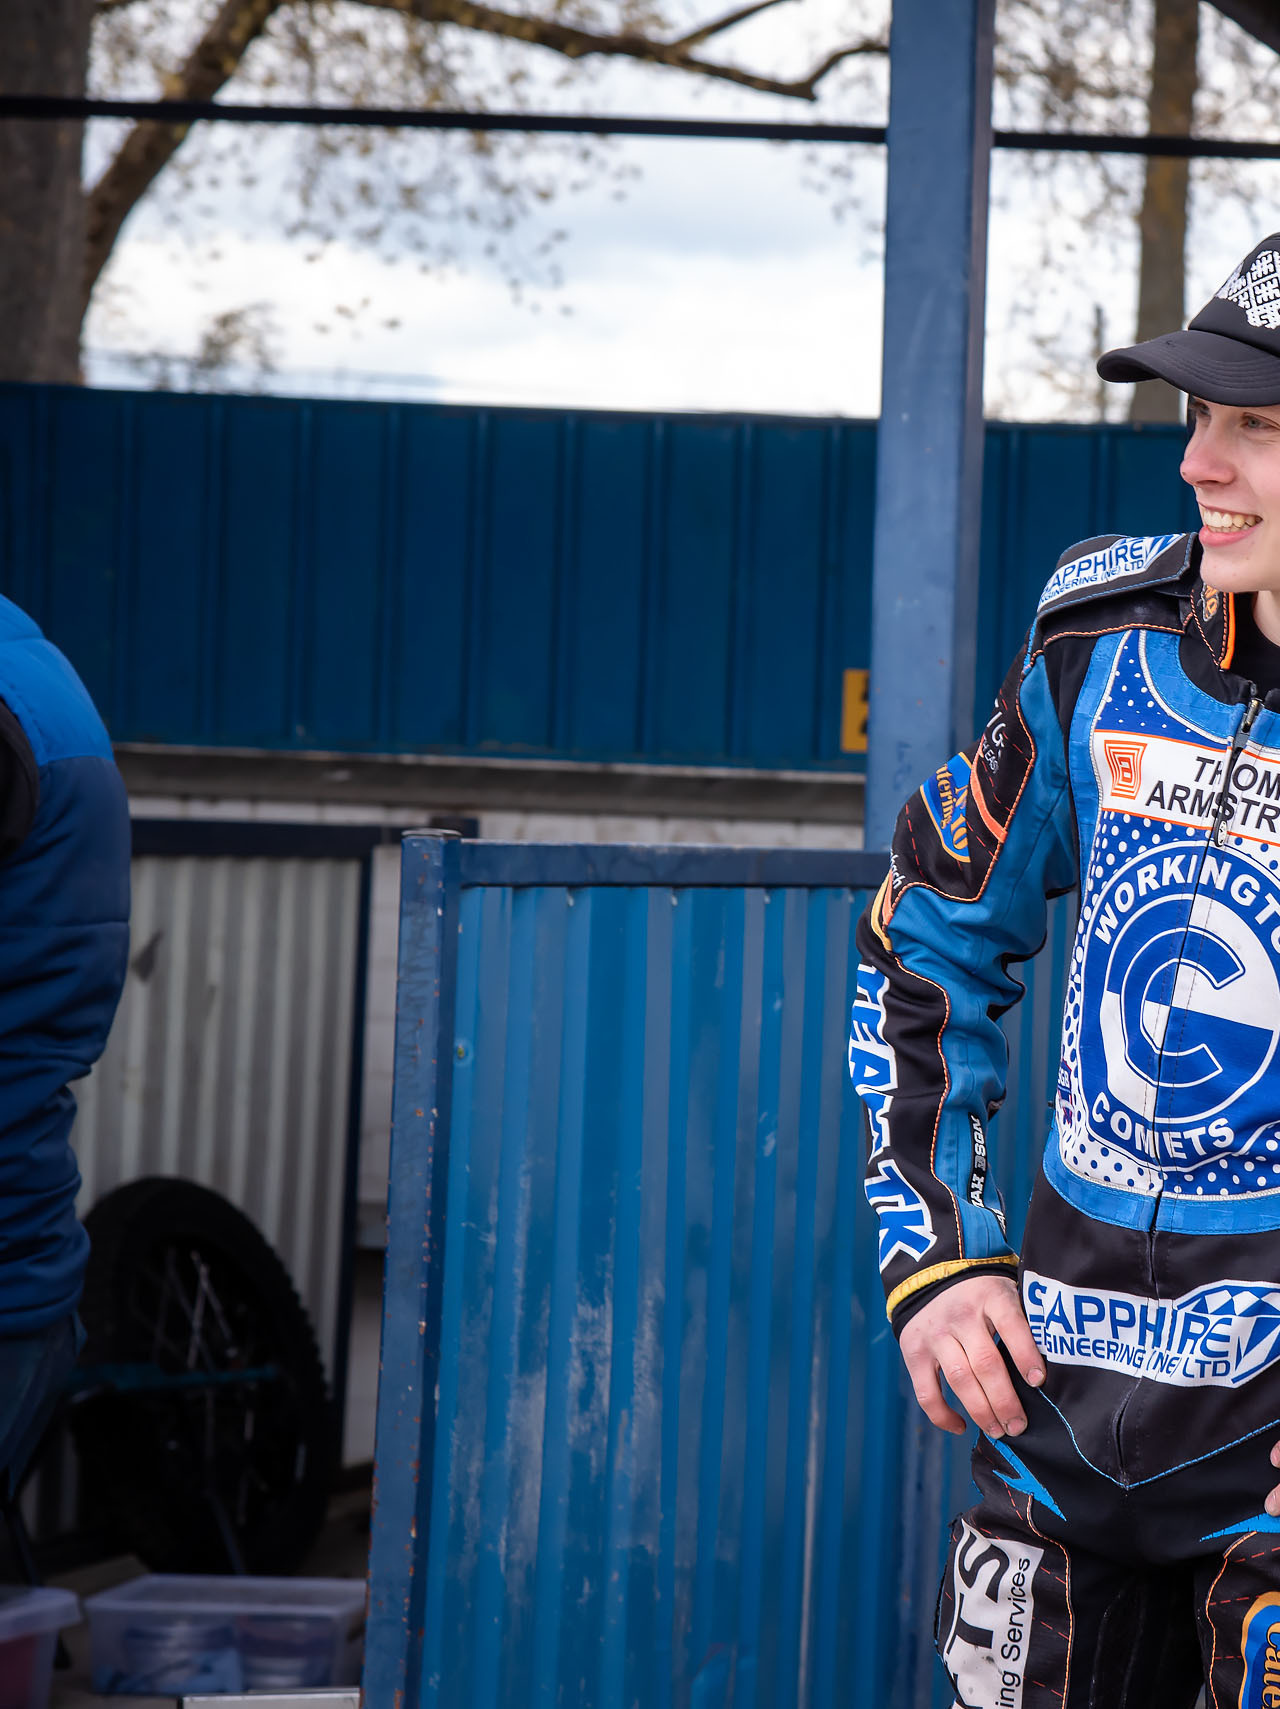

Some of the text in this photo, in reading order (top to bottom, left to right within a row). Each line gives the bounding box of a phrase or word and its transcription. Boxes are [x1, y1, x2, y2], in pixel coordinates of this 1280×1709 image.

[1124, 559, 1144, 572] LTD
[1091, 1091, 1235, 1160] COMETS
[1182, 1357, 1232, 1379] LTD
[1001, 1557, 1031, 1662] Services
